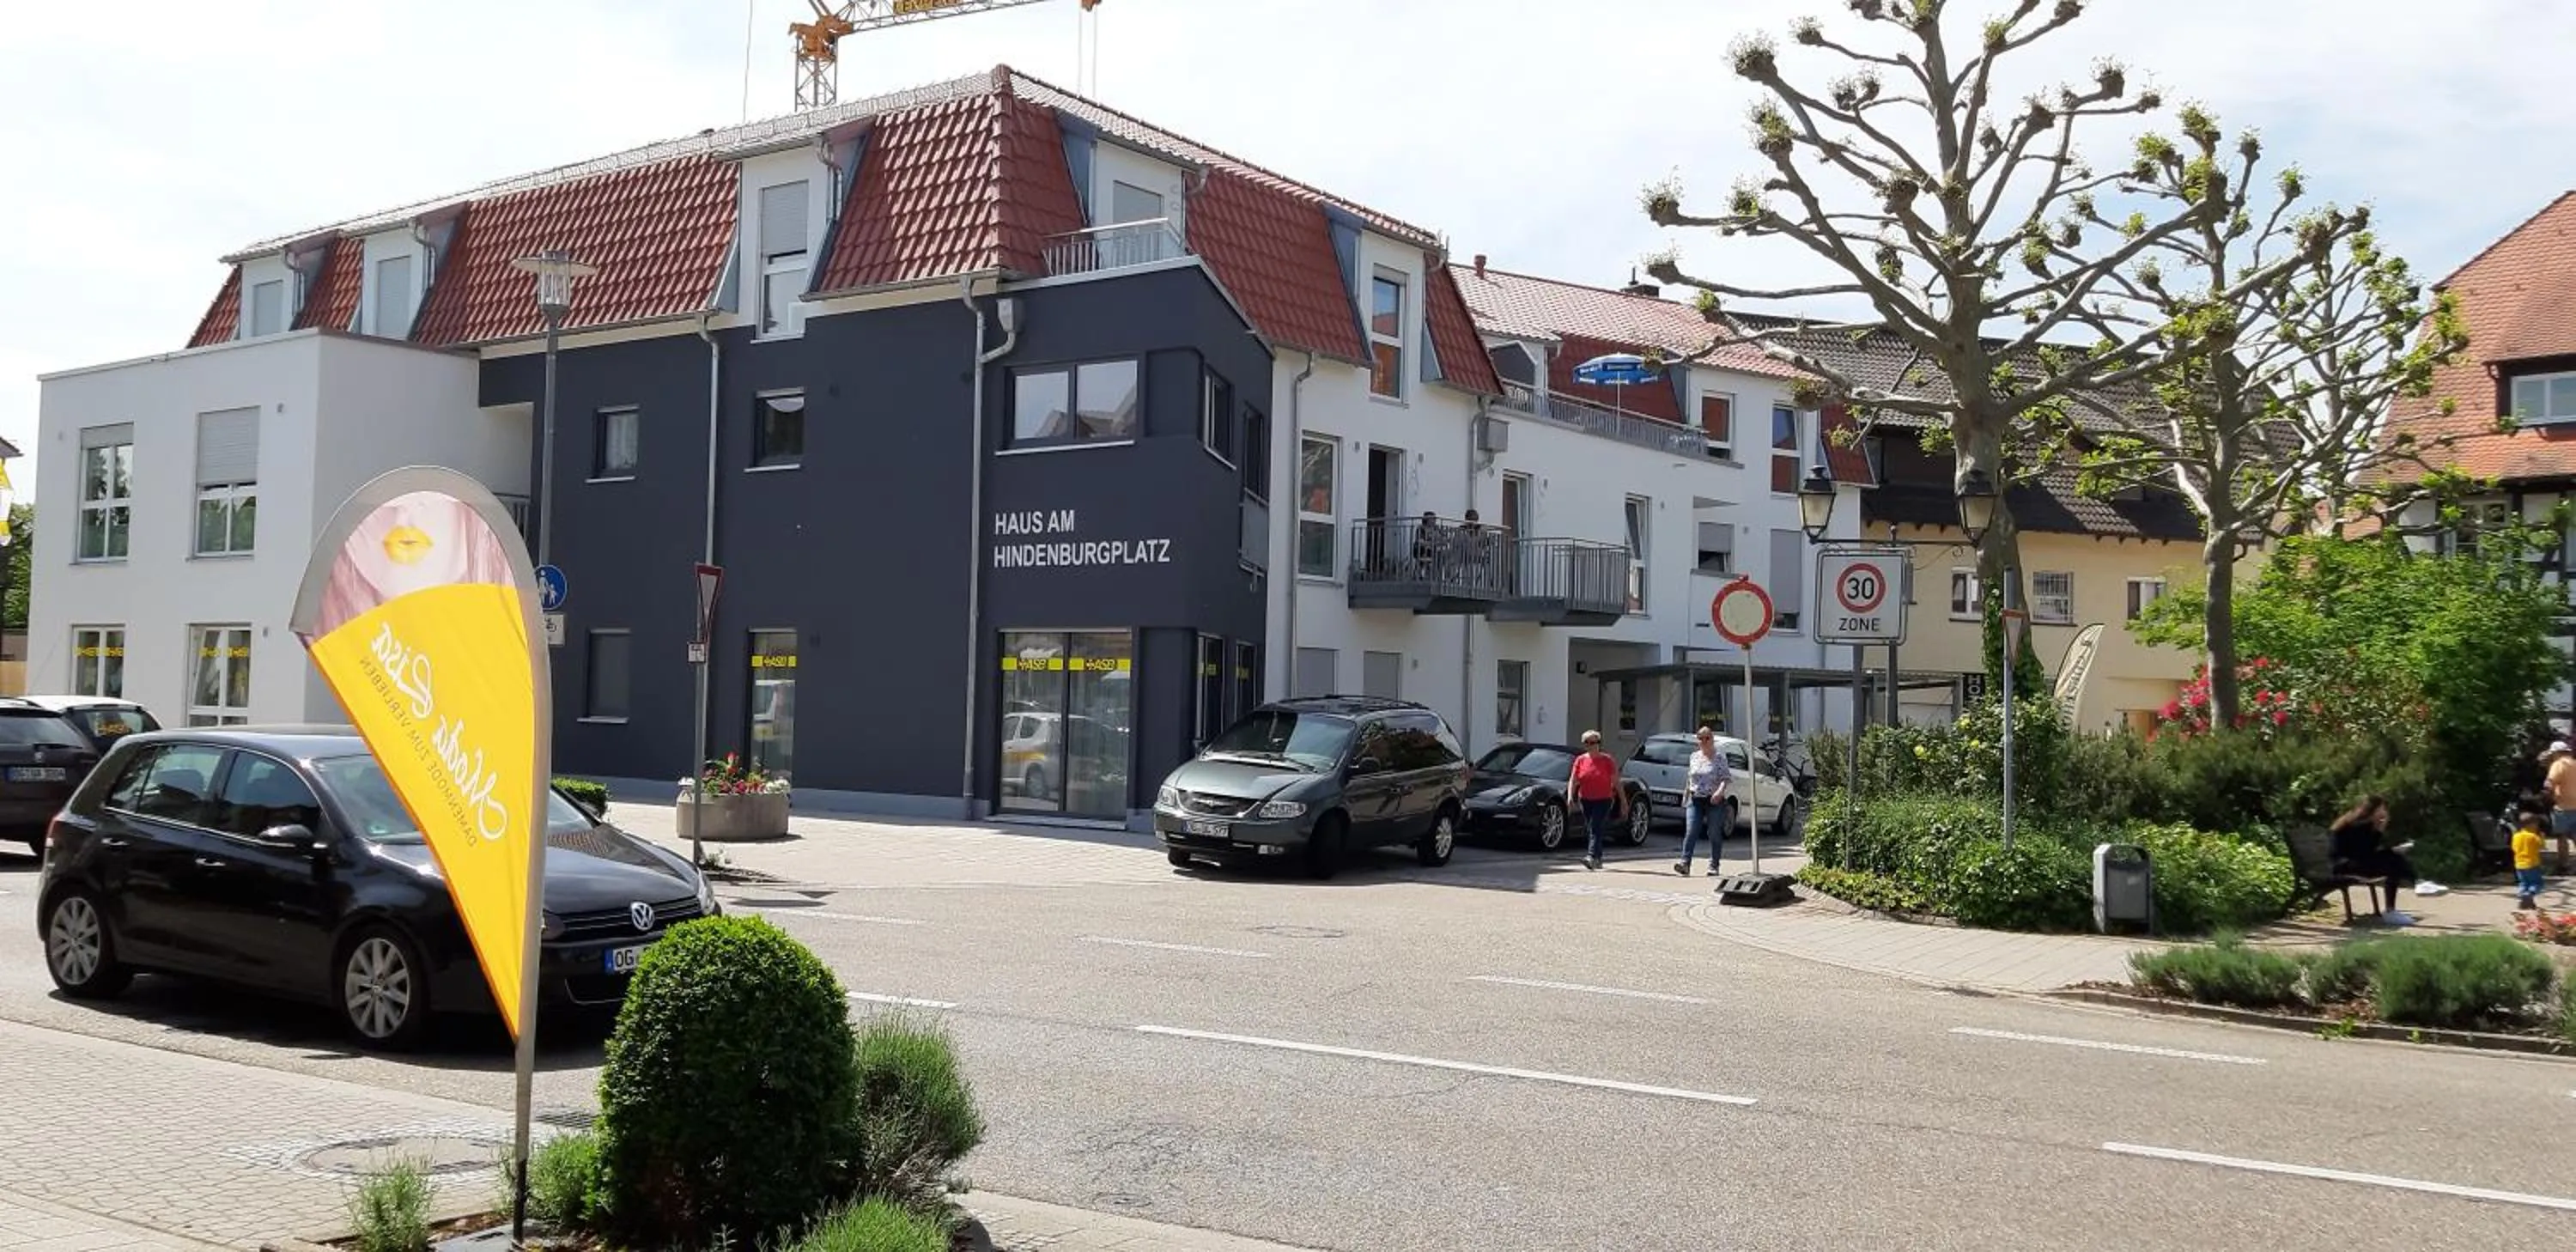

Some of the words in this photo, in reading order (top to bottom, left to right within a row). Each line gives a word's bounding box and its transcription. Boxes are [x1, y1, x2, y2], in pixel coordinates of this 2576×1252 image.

[995, 511, 1043, 535] HAUS
[1047, 509, 1075, 532] AM
[993, 538, 1170, 568] HINDENBURGPLATZ
[1847, 577, 1874, 599] 30
[1838, 617, 1880, 631] ZONE
[615, 949, 635, 968] OG
